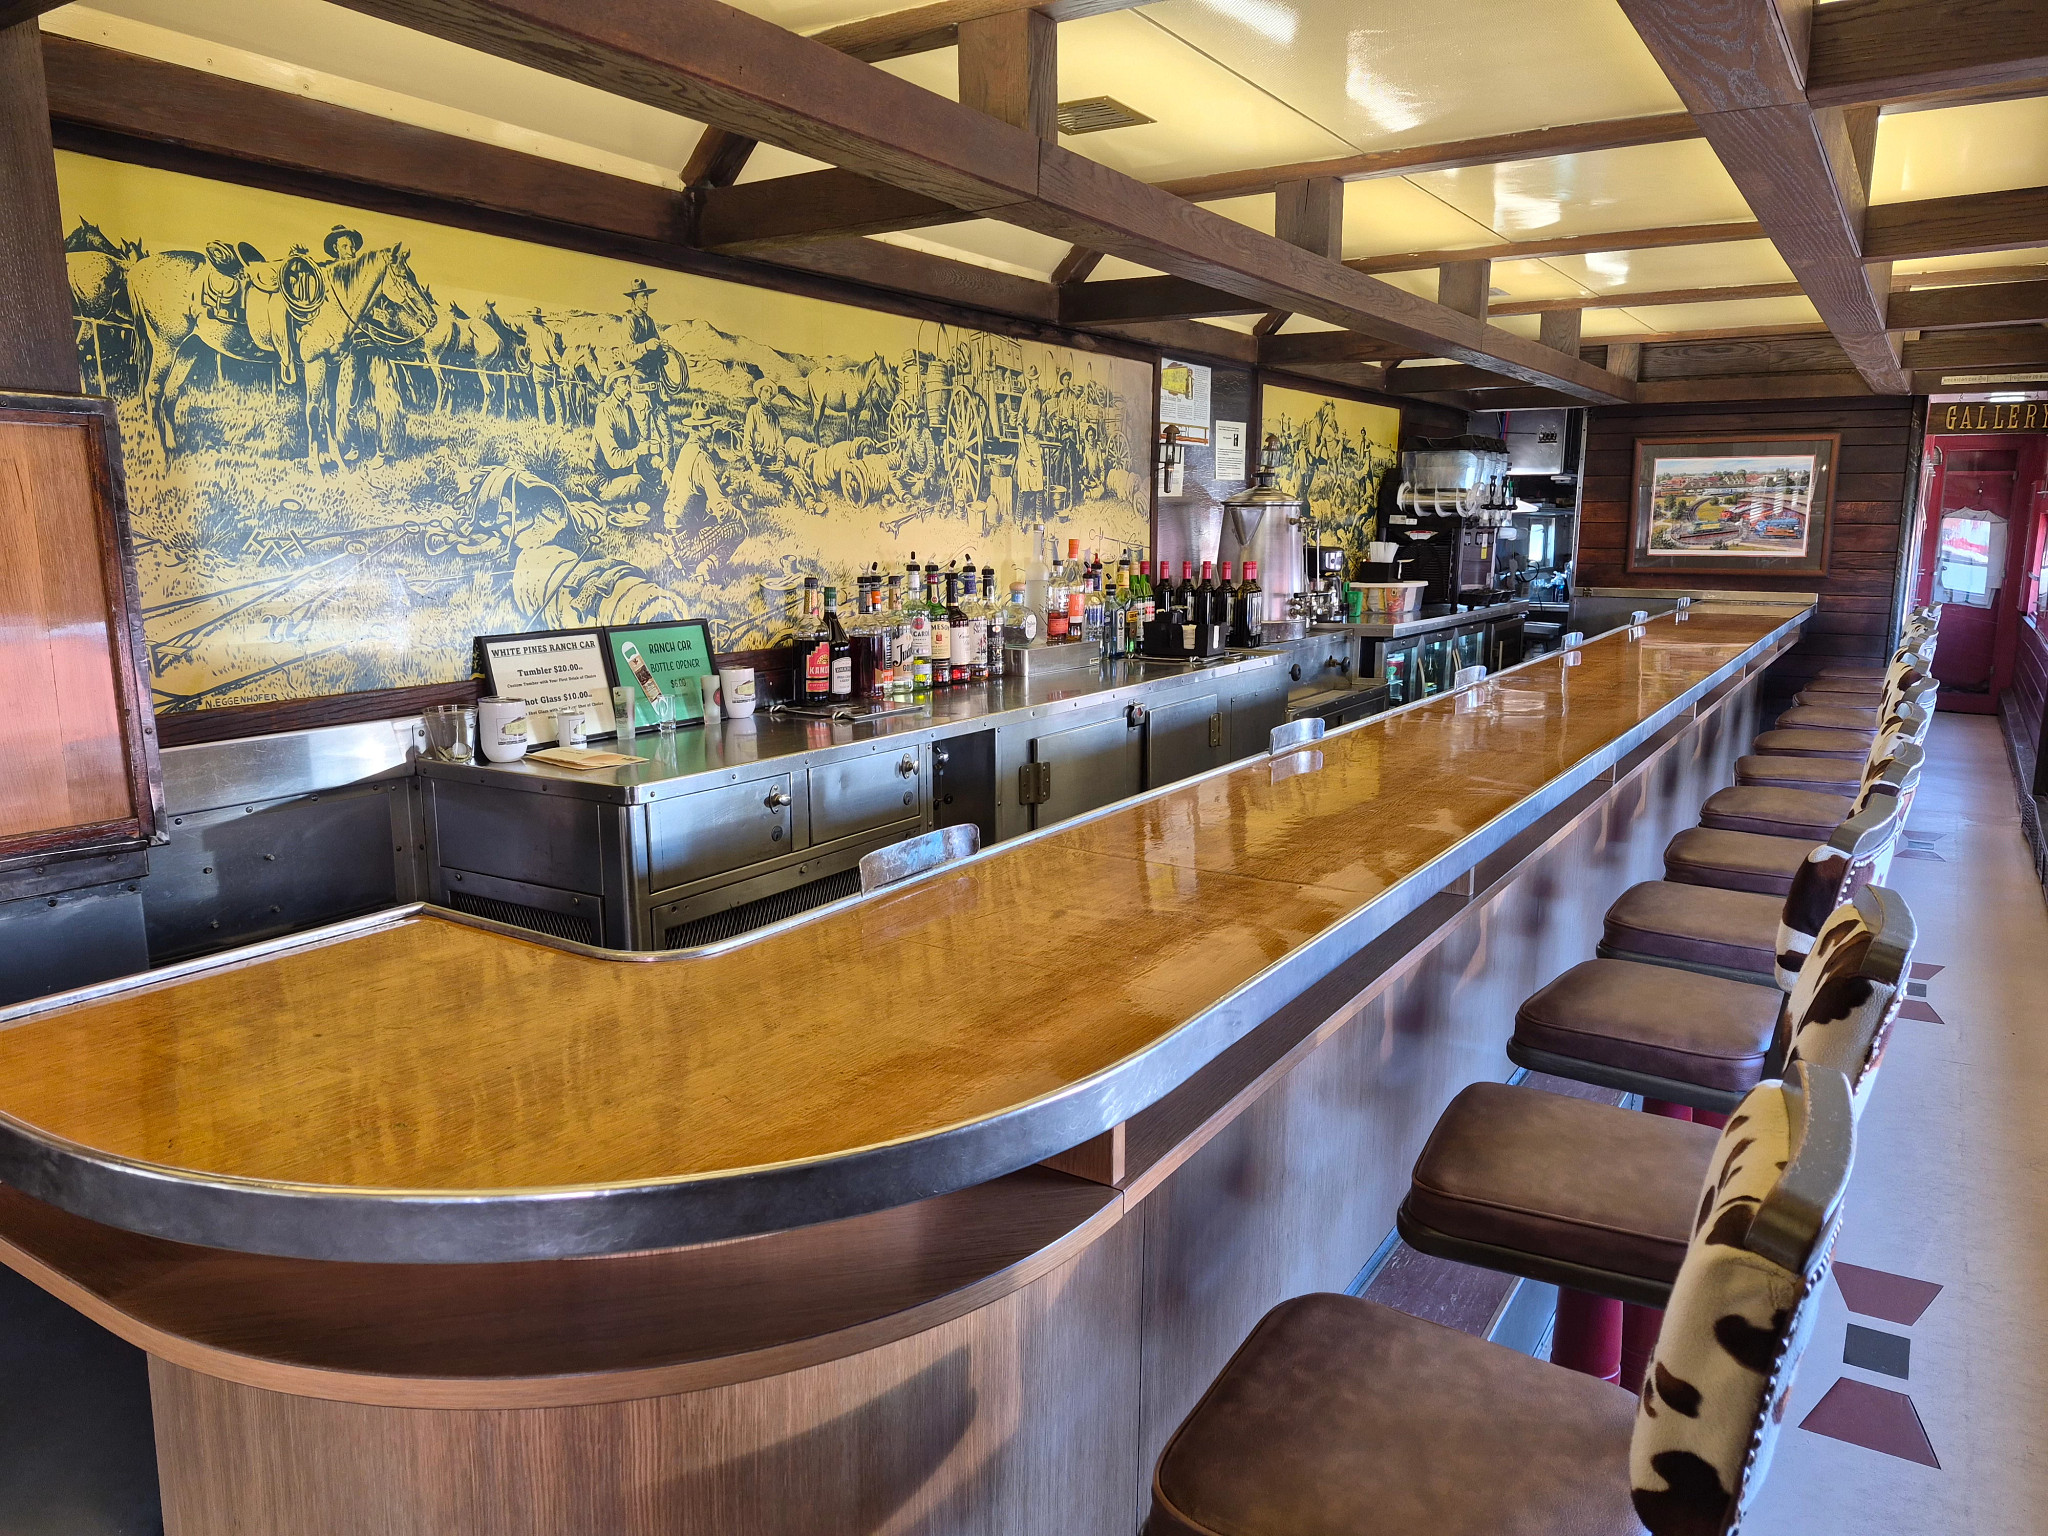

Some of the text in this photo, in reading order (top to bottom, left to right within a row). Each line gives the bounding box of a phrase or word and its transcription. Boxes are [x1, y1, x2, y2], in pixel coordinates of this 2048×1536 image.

[491, 640, 596, 657] WHITE PINES RANCH CAR
[648, 640, 692, 654] RANCH CAR
[517, 667, 552, 677] Tumbler
[650, 658, 700, 673] BOTTLE OPENER
[205, 693, 278, 709] N.EGGENHOFER
[524, 698, 539, 706] hot
[540, 695, 562, 704] Glass
